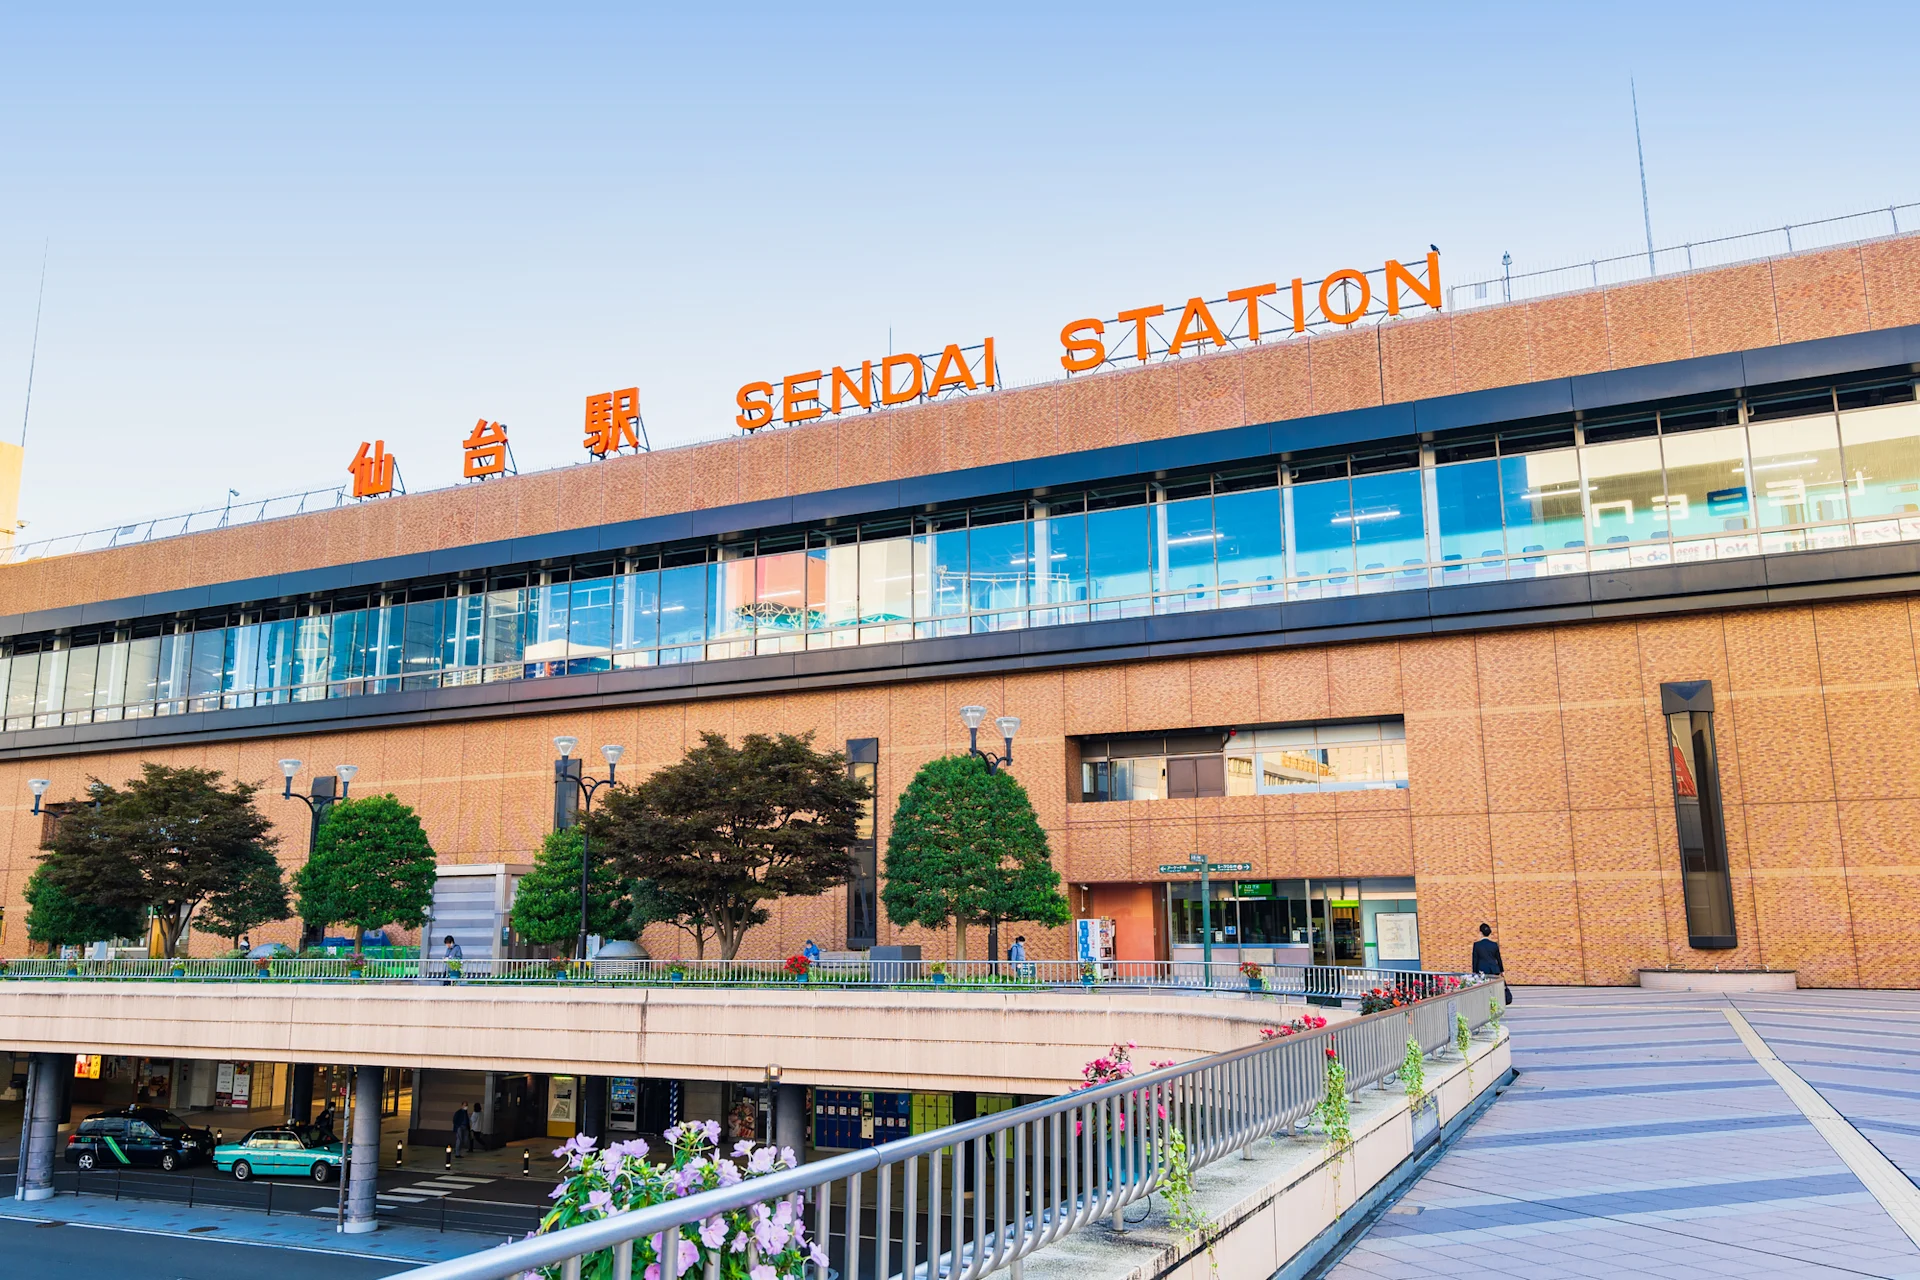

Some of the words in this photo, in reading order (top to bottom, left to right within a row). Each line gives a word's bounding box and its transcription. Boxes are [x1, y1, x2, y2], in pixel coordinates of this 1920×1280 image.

[736, 337, 995, 430] SENDAI
[1060, 251, 1442, 372] STATION
[347, 387, 640, 497] 仙台駅
